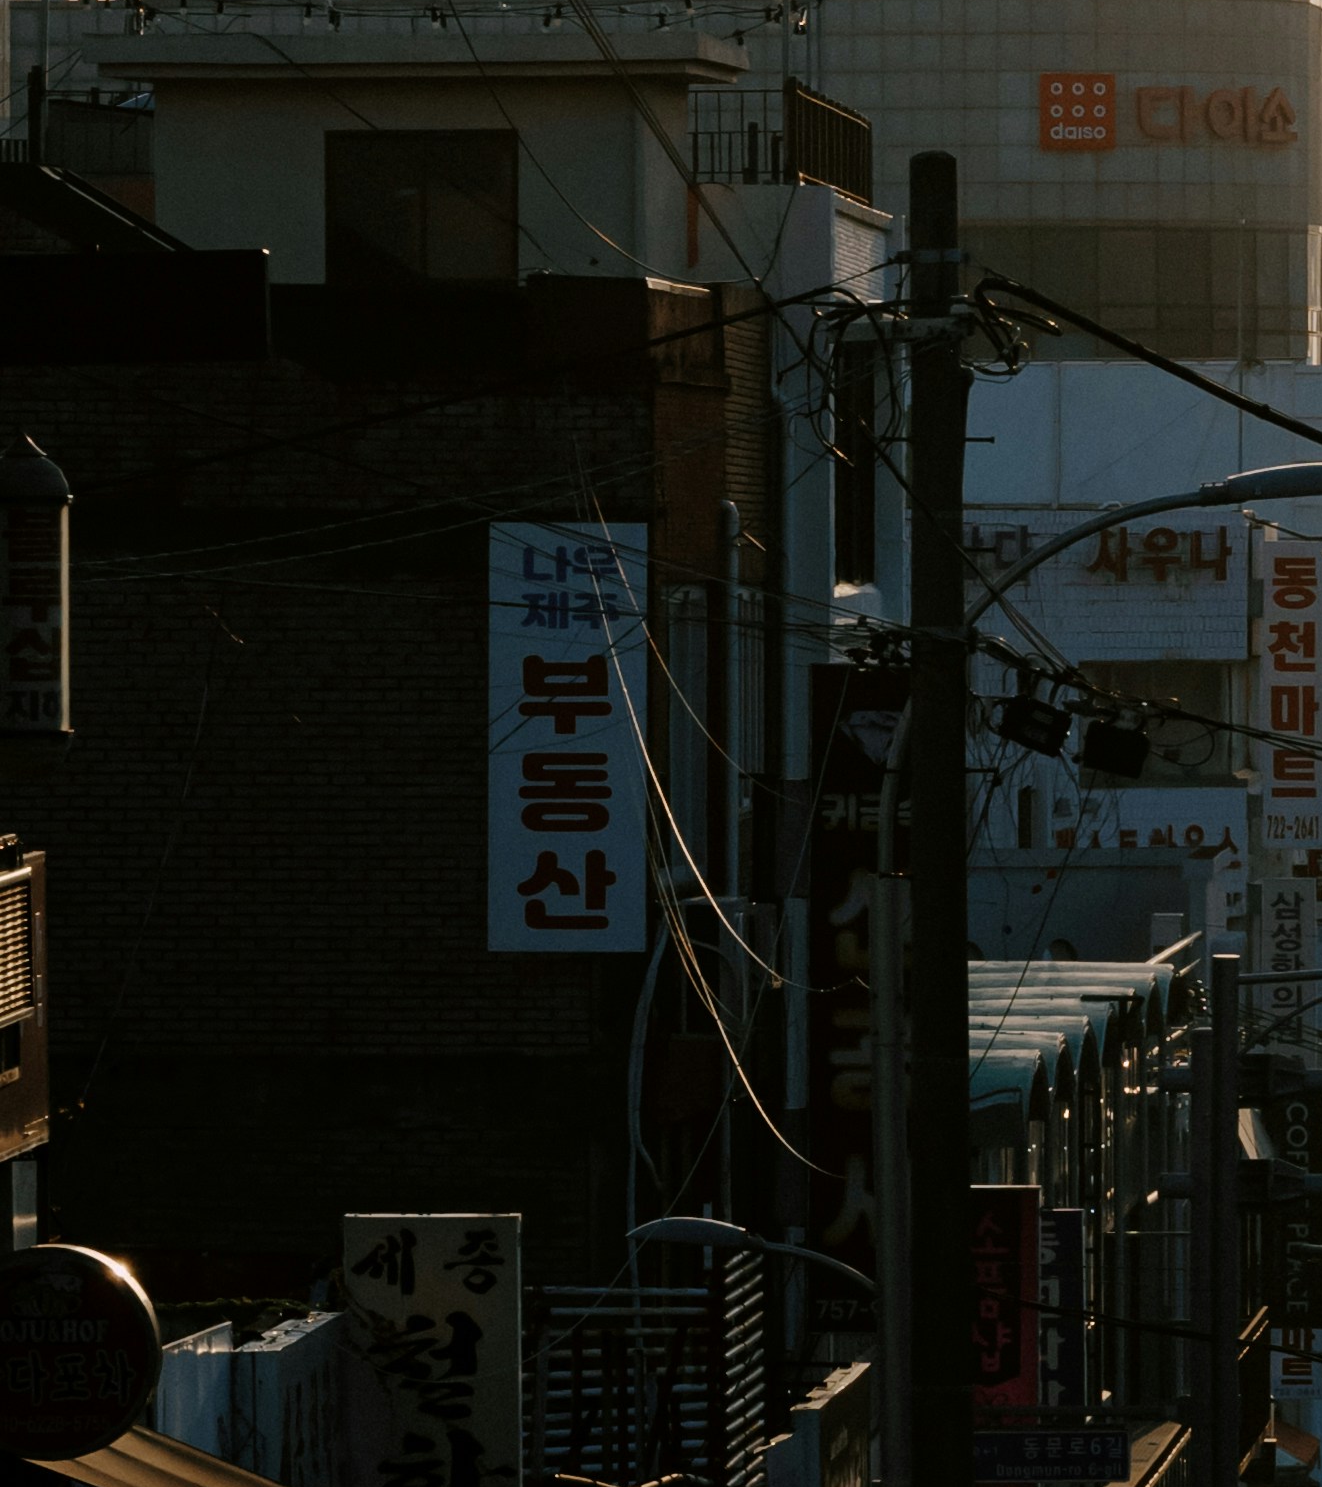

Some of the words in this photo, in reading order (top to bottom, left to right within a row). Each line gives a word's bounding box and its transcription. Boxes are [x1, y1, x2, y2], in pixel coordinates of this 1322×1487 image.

[1050, 122, 1107, 140] daiso
[1135, 85, 1299, 146] 다이소
[522, 545, 620, 583] 나우
[1087, 525, 1232, 582] 사우나
[520, 591, 620, 630] 제주
[1267, 557, 1320, 798] 동천마트
[517, 654, 617, 930] 부동산
[1269, 890, 1307, 1026] 삼성한의
[815, 1298, 878, 1320] 757-
[1022, 1436, 1123, 1460] 동문로6길
